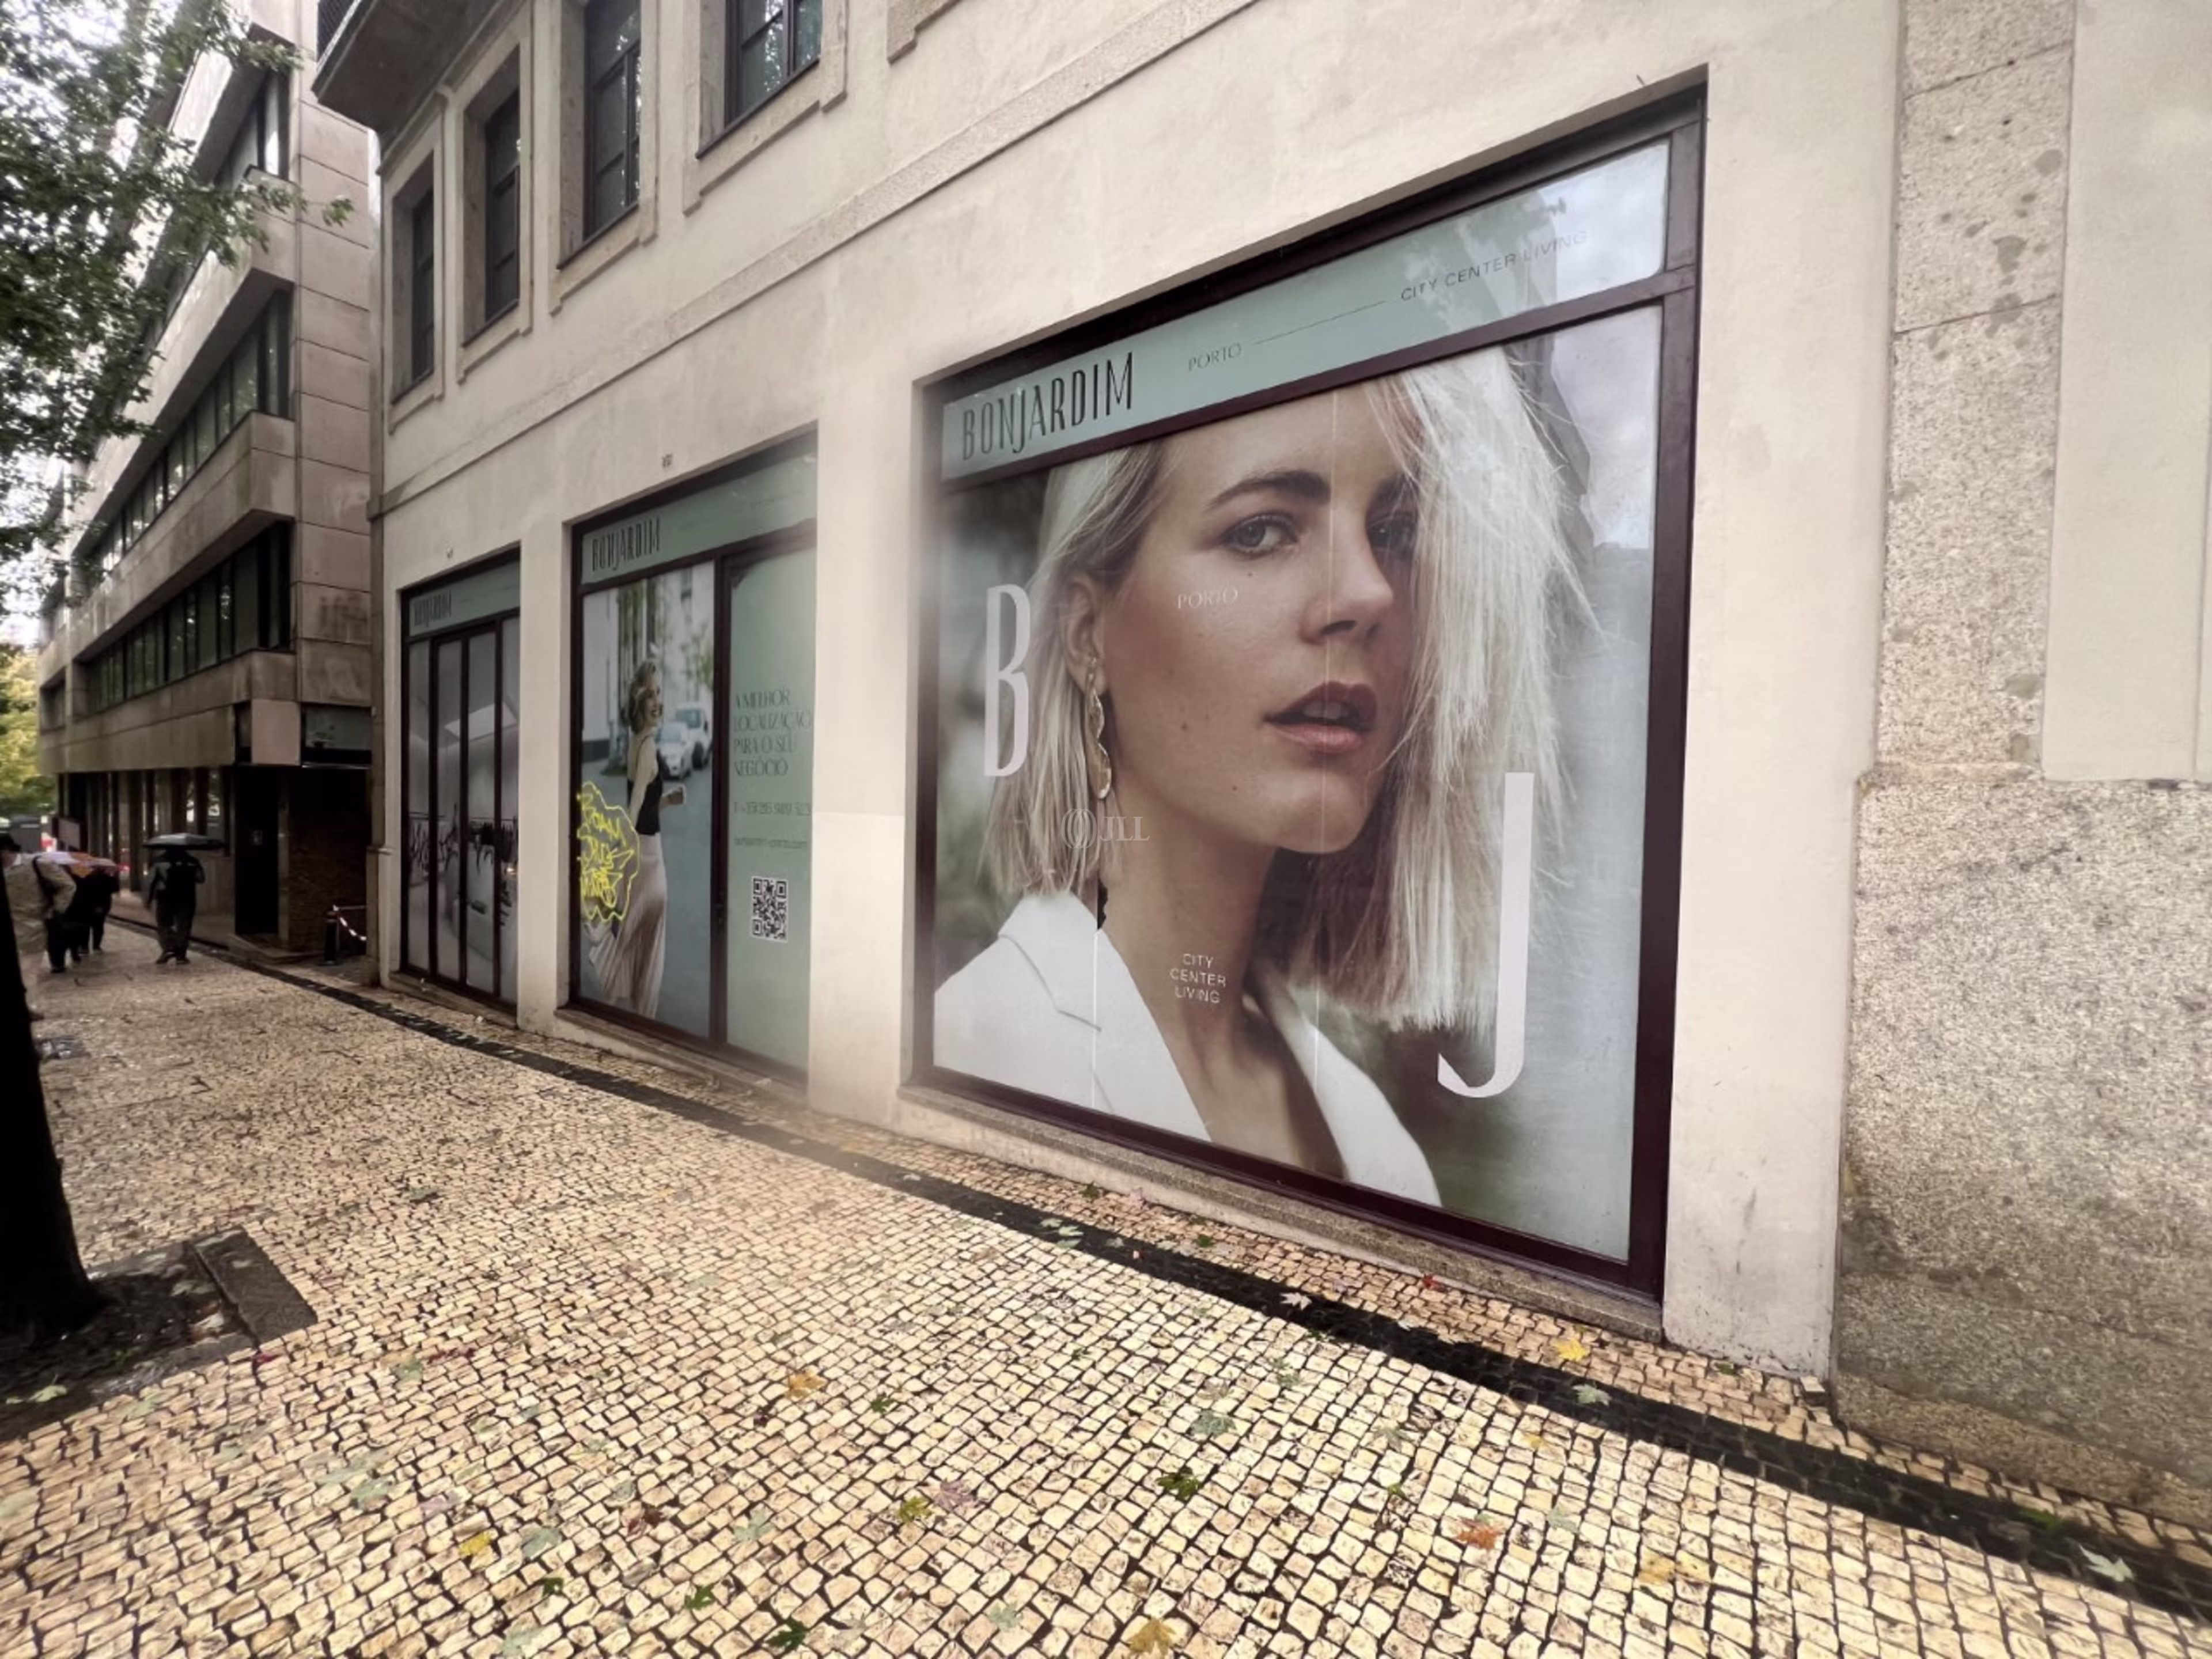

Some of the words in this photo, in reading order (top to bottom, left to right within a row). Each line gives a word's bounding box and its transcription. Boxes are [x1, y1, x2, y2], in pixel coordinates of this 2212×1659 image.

[1400, 278, 1437, 301] CITY
[1445, 253, 1517, 287] CENTER
[1522, 231, 1588, 262] LIVING
[1188, 343, 1241, 372] PORTO
[962, 352, 1133, 460] BONJARDIM
[592, 517, 661, 571] BONJARDIM
[1177, 588, 1238, 609] PORTO
[984, 584, 1031, 777] B
[1099, 816, 1150, 842] JLL
[1437, 772, 1534, 1098] J
[1183, 953, 1213, 968] CITY
[1170, 968, 1226, 987] CENTER
[1175, 986, 1221, 1003] LIVING
